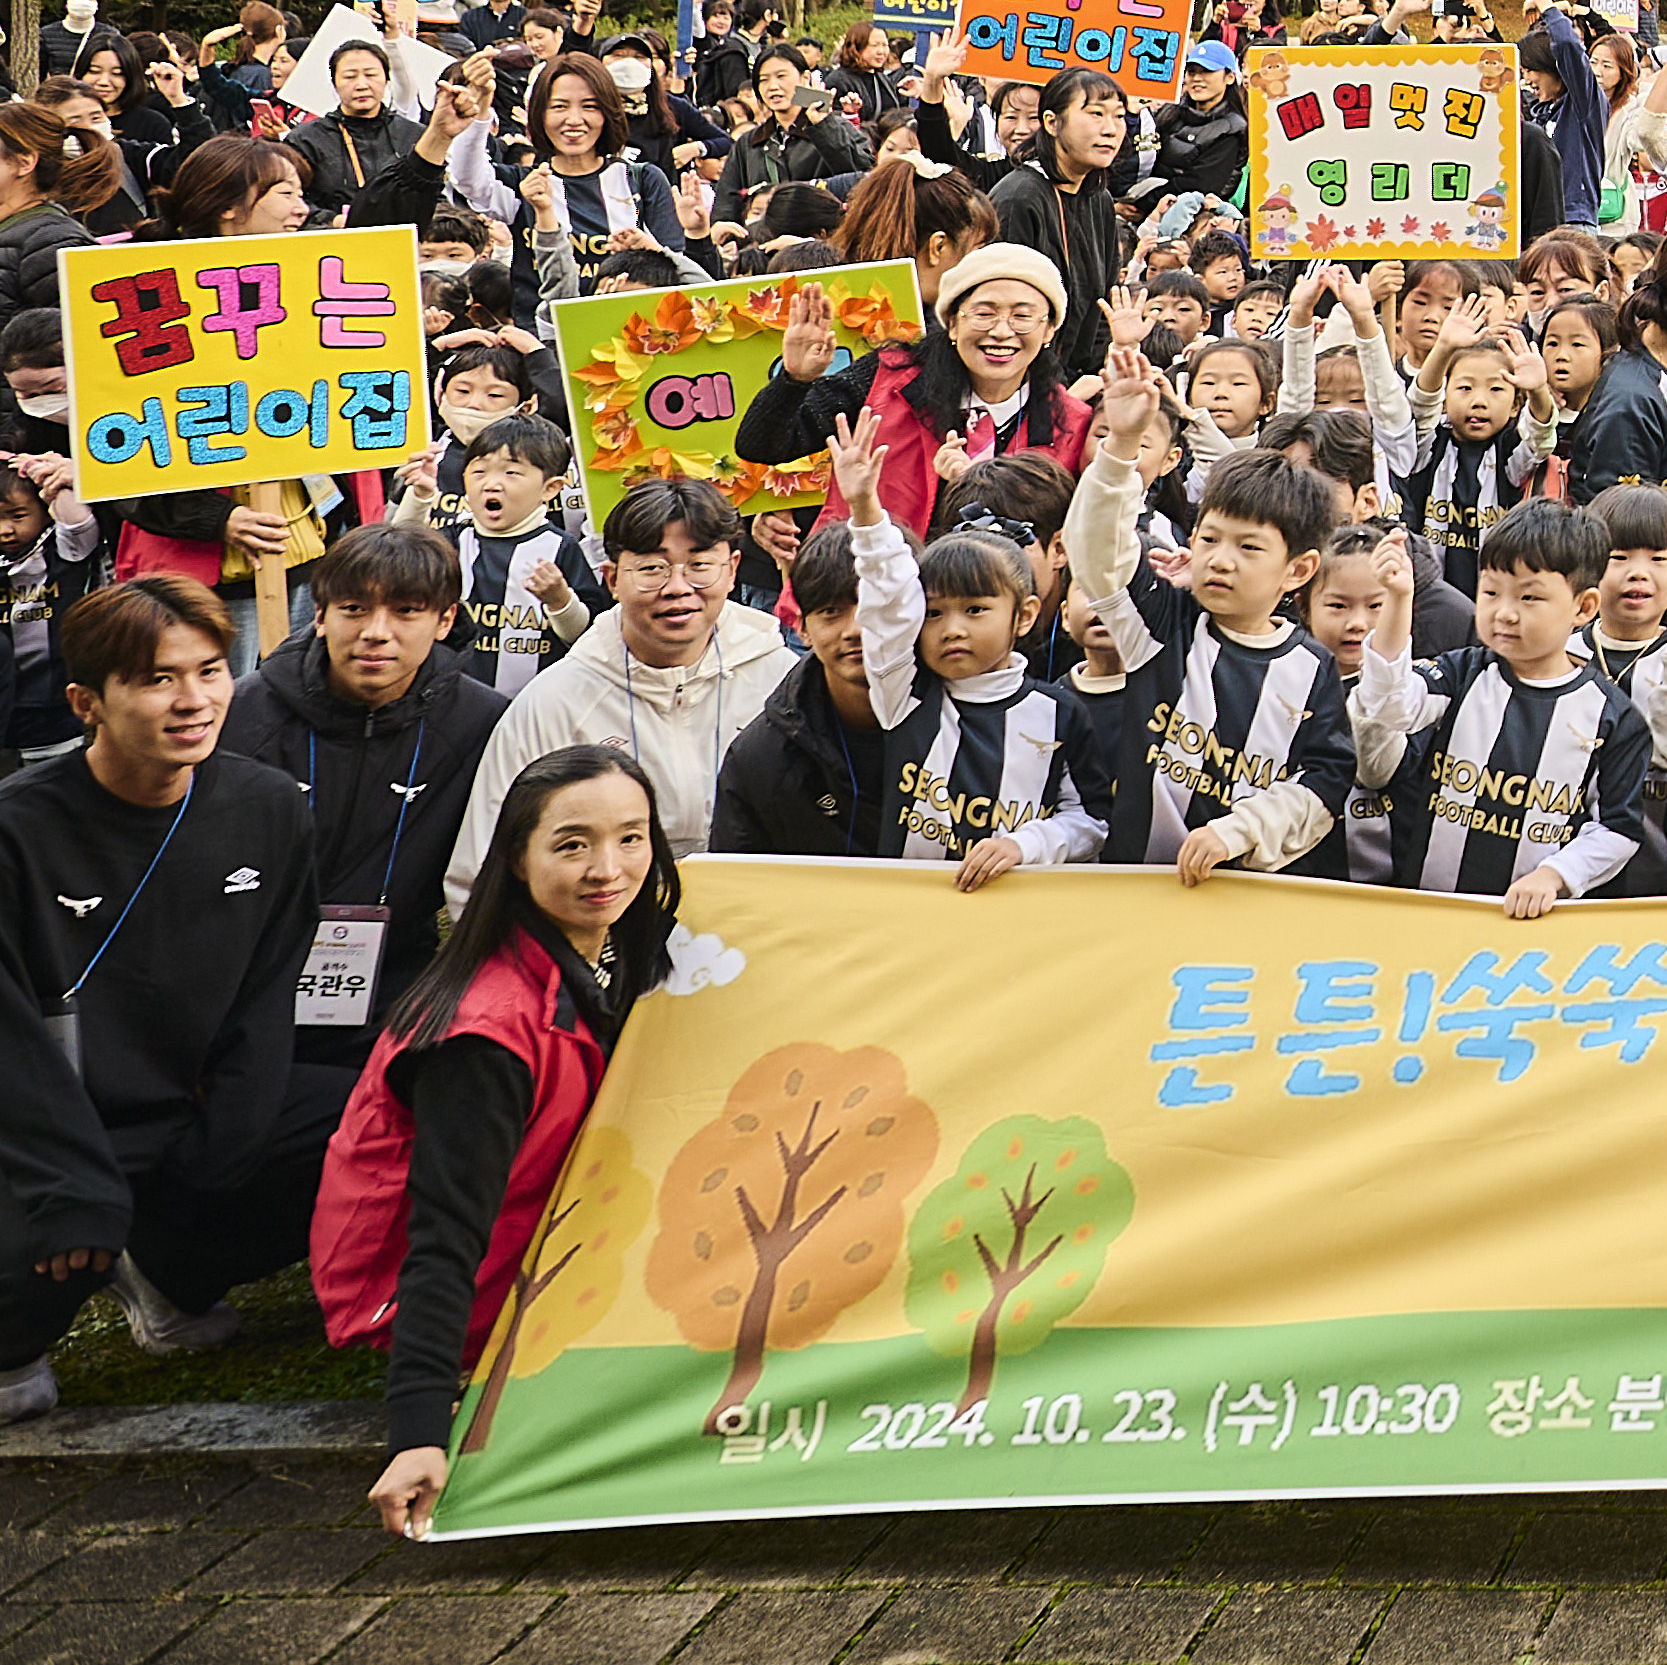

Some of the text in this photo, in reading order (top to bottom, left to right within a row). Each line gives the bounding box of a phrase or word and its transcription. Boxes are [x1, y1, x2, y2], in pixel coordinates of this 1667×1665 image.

[967, 11, 1180, 84] 어린이집
[91, 254, 398, 378] 꿈꾸는
[86, 369, 411, 470] 어린이집
[13, 606, 54, 623] CLUB
[503, 637, 552, 655] CLUB
[1146, 743, 1234, 809] FOOTBAL
[1351, 792, 1395, 820] CLUB
[1427, 792, 1574, 844] FOOTBALL CLUB
[296, 974, 366, 998] 국관우
[714, 1398, 827, 1466] 일시
[847, 1395, 996, 1455] 2024.
[1011, 1392, 1092, 1448] 10.
[1101, 1386, 1189, 1446] 23.
[1204, 1378, 1297, 1455] (수)
[1311, 1380, 1462, 1438] 10:30
[1486, 1374, 1596, 1438] 장소
